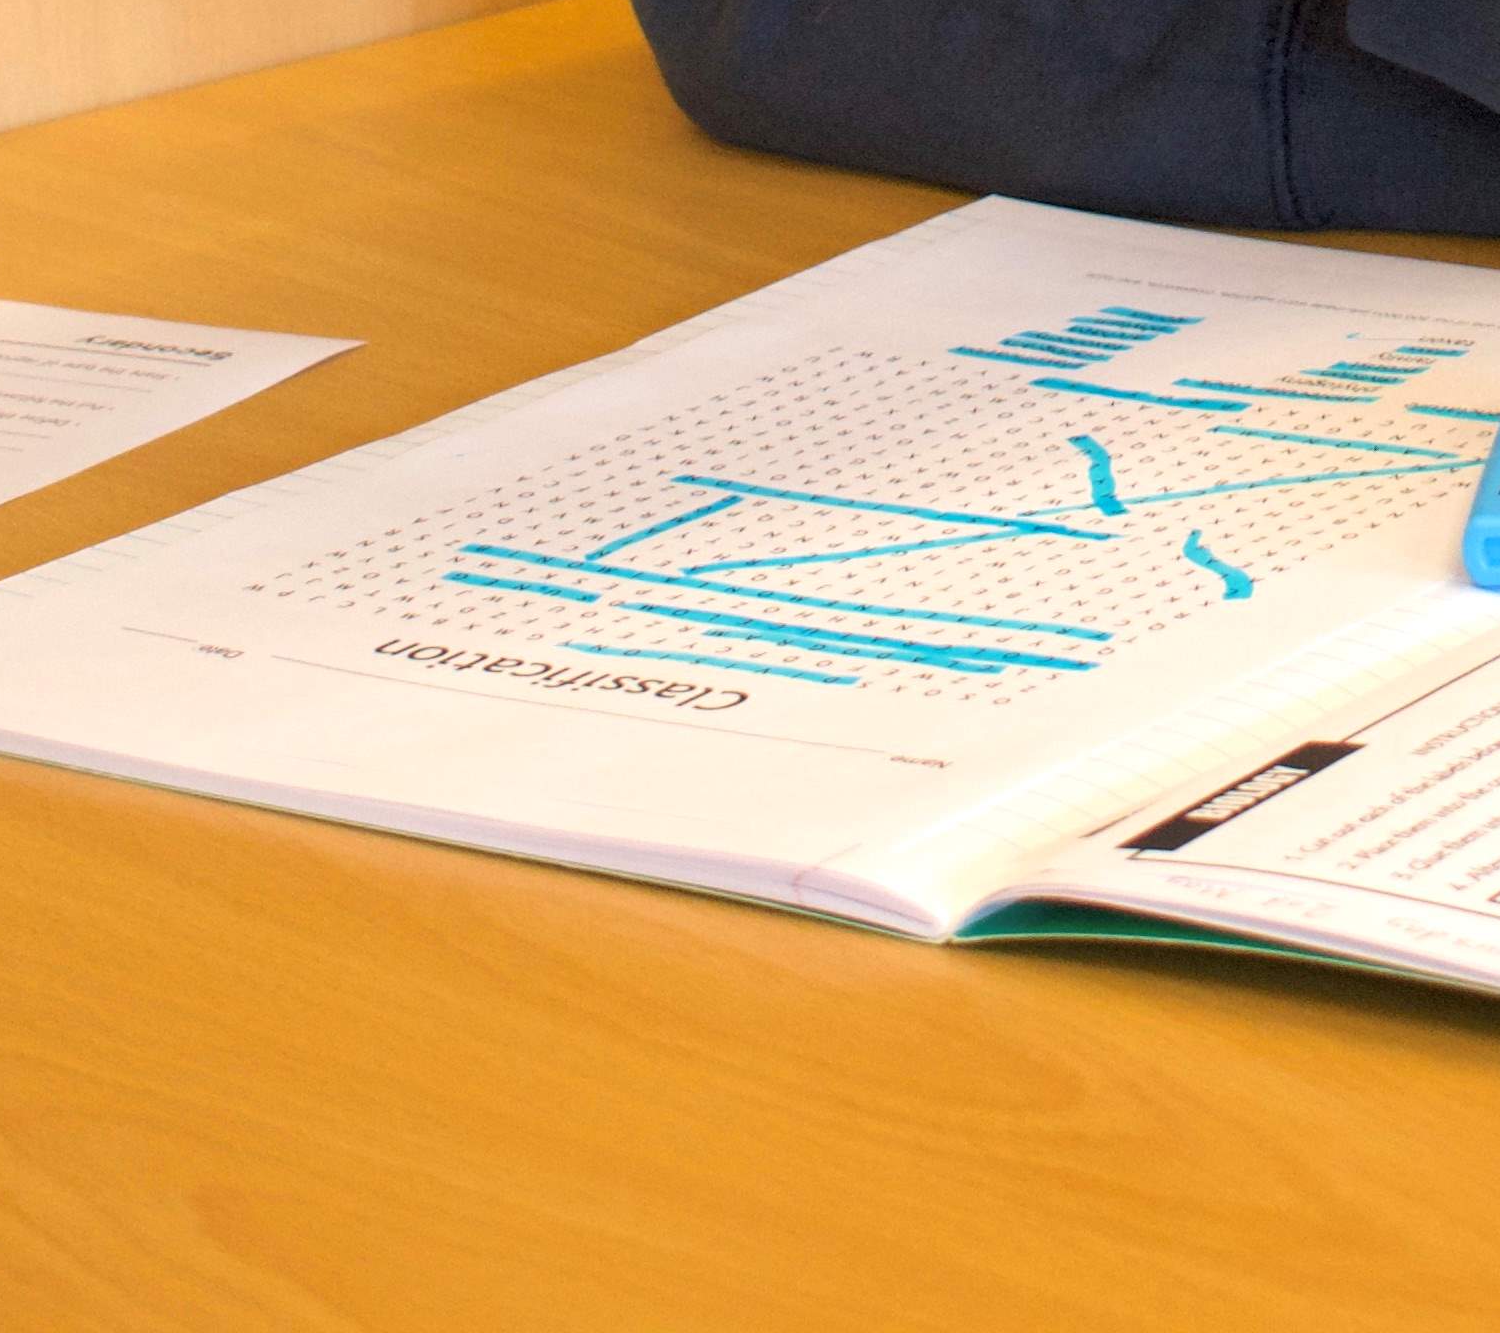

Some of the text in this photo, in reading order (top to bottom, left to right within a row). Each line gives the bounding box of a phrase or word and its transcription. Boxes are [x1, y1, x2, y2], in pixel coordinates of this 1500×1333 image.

[78, 335, 232, 361] Secondary
[375, 639, 747, 710] Classification
[1183, 763, 1314, 822] BIOLOGY
